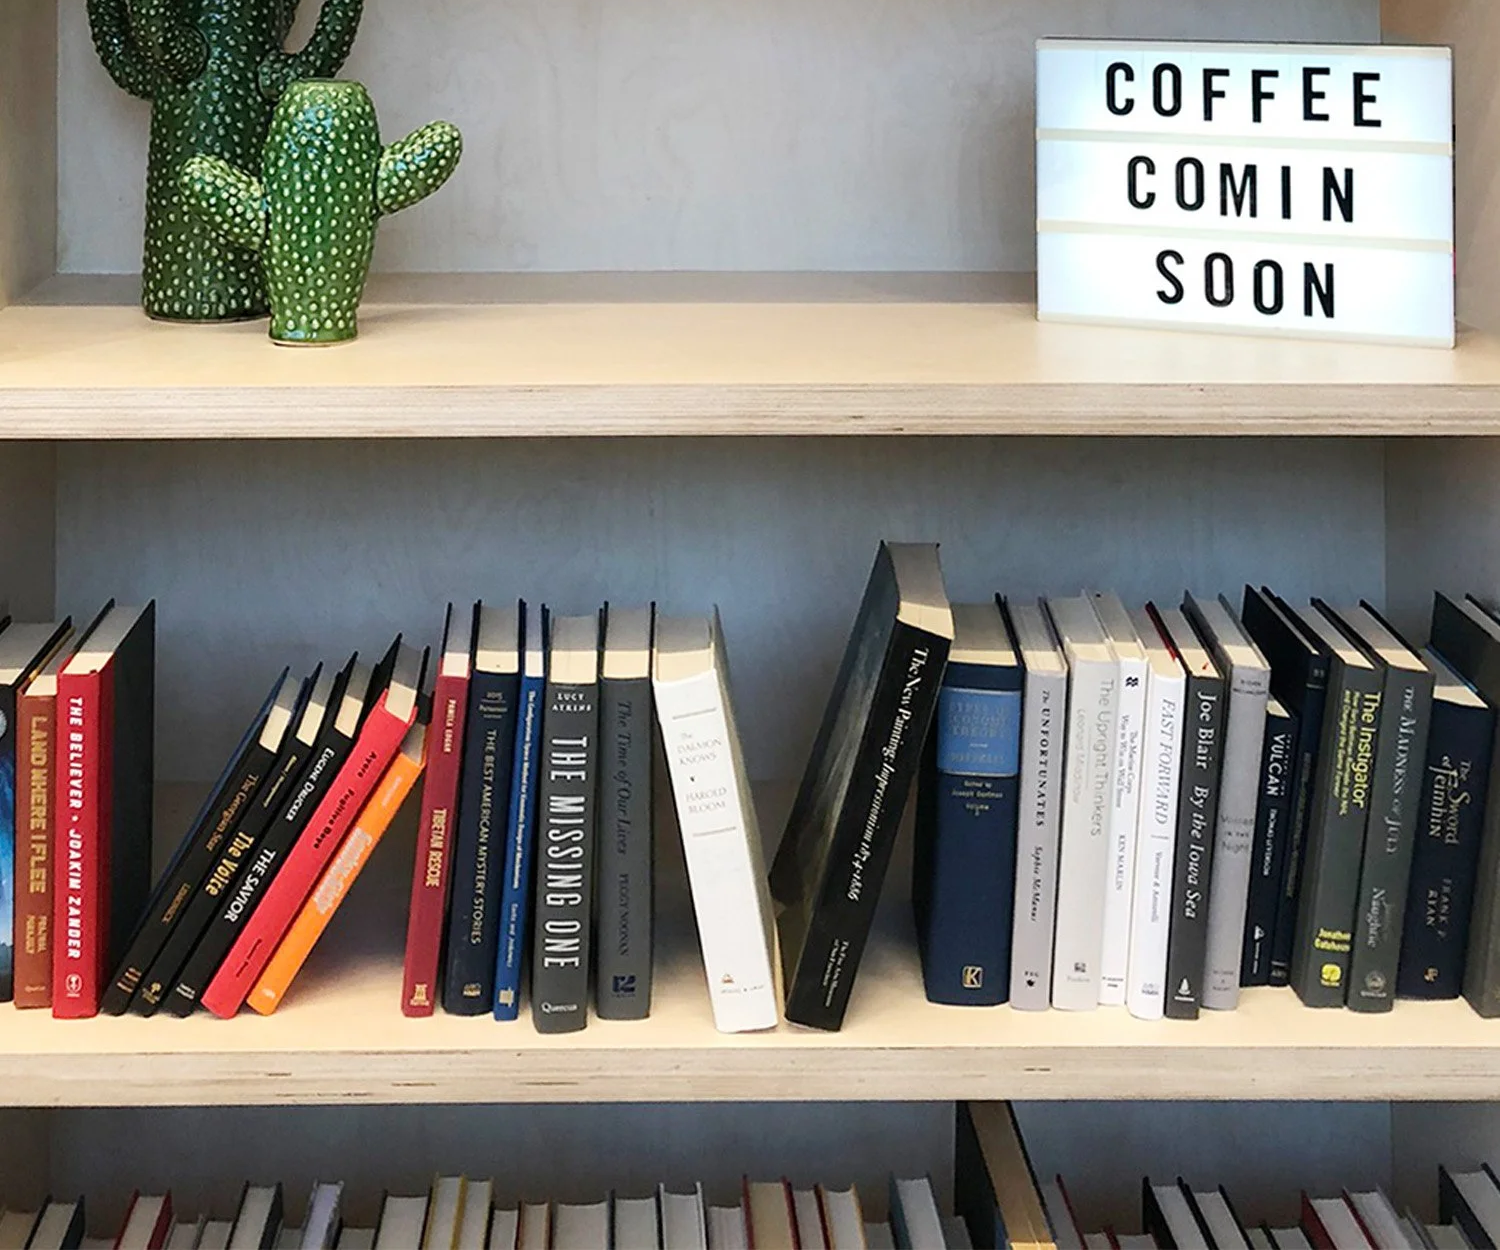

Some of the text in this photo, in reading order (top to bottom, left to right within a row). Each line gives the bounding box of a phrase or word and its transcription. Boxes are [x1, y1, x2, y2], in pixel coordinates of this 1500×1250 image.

[1105, 61, 1382, 127] COFFEE
[1127, 155, 1354, 223] COMIN
[1156, 249, 1335, 318] SOON
[552, 704, 592, 712] ATKINS
[557, 693, 585, 701] LUCY
[1195, 691, 1217, 770] Joe Blair
[483, 755, 496, 782] BEST
[486, 729, 497, 751] THE
[846, 646, 930, 901] The New Painting: Impressionism 1874-1886
[1036, 690, 1050, 827] The UNFORTUNATES
[1090, 678, 1114, 837] The Upright Thinkers
[1154, 698, 1177, 825] FAST FORWARD
[1266, 733, 1286, 797] VULCAN
[1351, 691, 1381, 809] The Instigator
[29, 716, 48, 894] LAND WHERE FLEE
[205, 773, 259, 851] The Georgian Star
[285, 747, 335, 822] EUGENE DRUCKER
[312, 751, 379, 850] Ayers Fugitive Days
[478, 784, 493, 843] AMERICAN
[613, 701, 632, 856] The Time of Our Lives
[1383, 715, 1417, 856] MADNESS JULY
[1444, 759, 1472, 846] The Sword
[67, 696, 83, 959] THE BELIEVER JOAKIM ZANDER
[205, 831, 255, 897] The Voice
[251, 847, 277, 875] THE
[425, 808, 448, 887] TIBETAN RESCUE
[543, 736, 588, 968] THE MISSING ONE
[1031, 845, 1043, 875] Sophie
[1184, 785, 1209, 919] By the Iowa Sea
[224, 873, 260, 924] SAVIOR
[474, 846, 488, 894] MYSTERY
[1425, 888, 1438, 926] RYAN
[471, 898, 486, 944] STORIES
